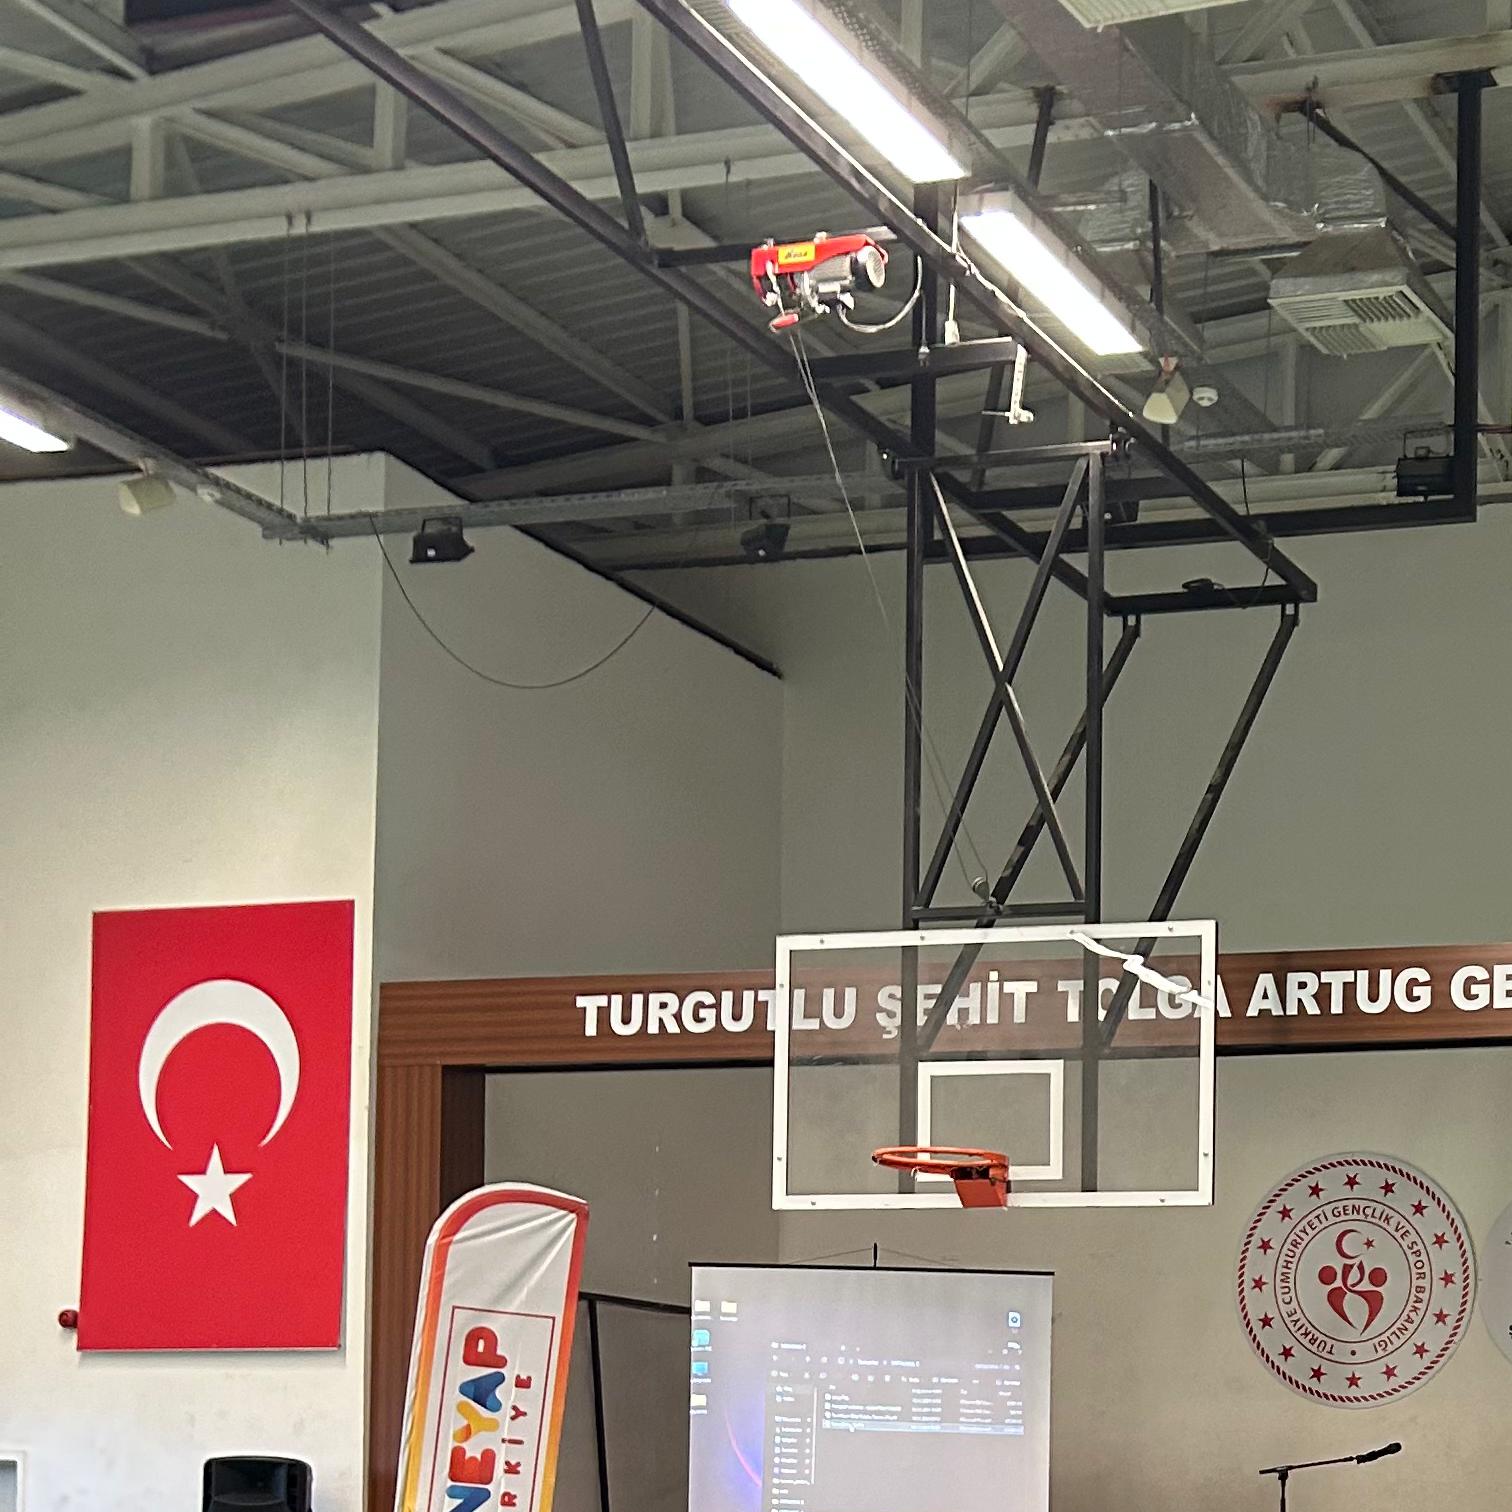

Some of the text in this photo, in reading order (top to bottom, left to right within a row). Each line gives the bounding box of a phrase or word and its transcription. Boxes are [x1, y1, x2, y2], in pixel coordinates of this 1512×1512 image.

[576, 987, 857, 1036] TURGUTLU
[1246, 967, 1432, 1017] ARTUG
[1280, 1204, 1427, 1356] TÜRKİYE CUMHURİYETİ GENÇLİK VE SPOR BAKANLIĞI
